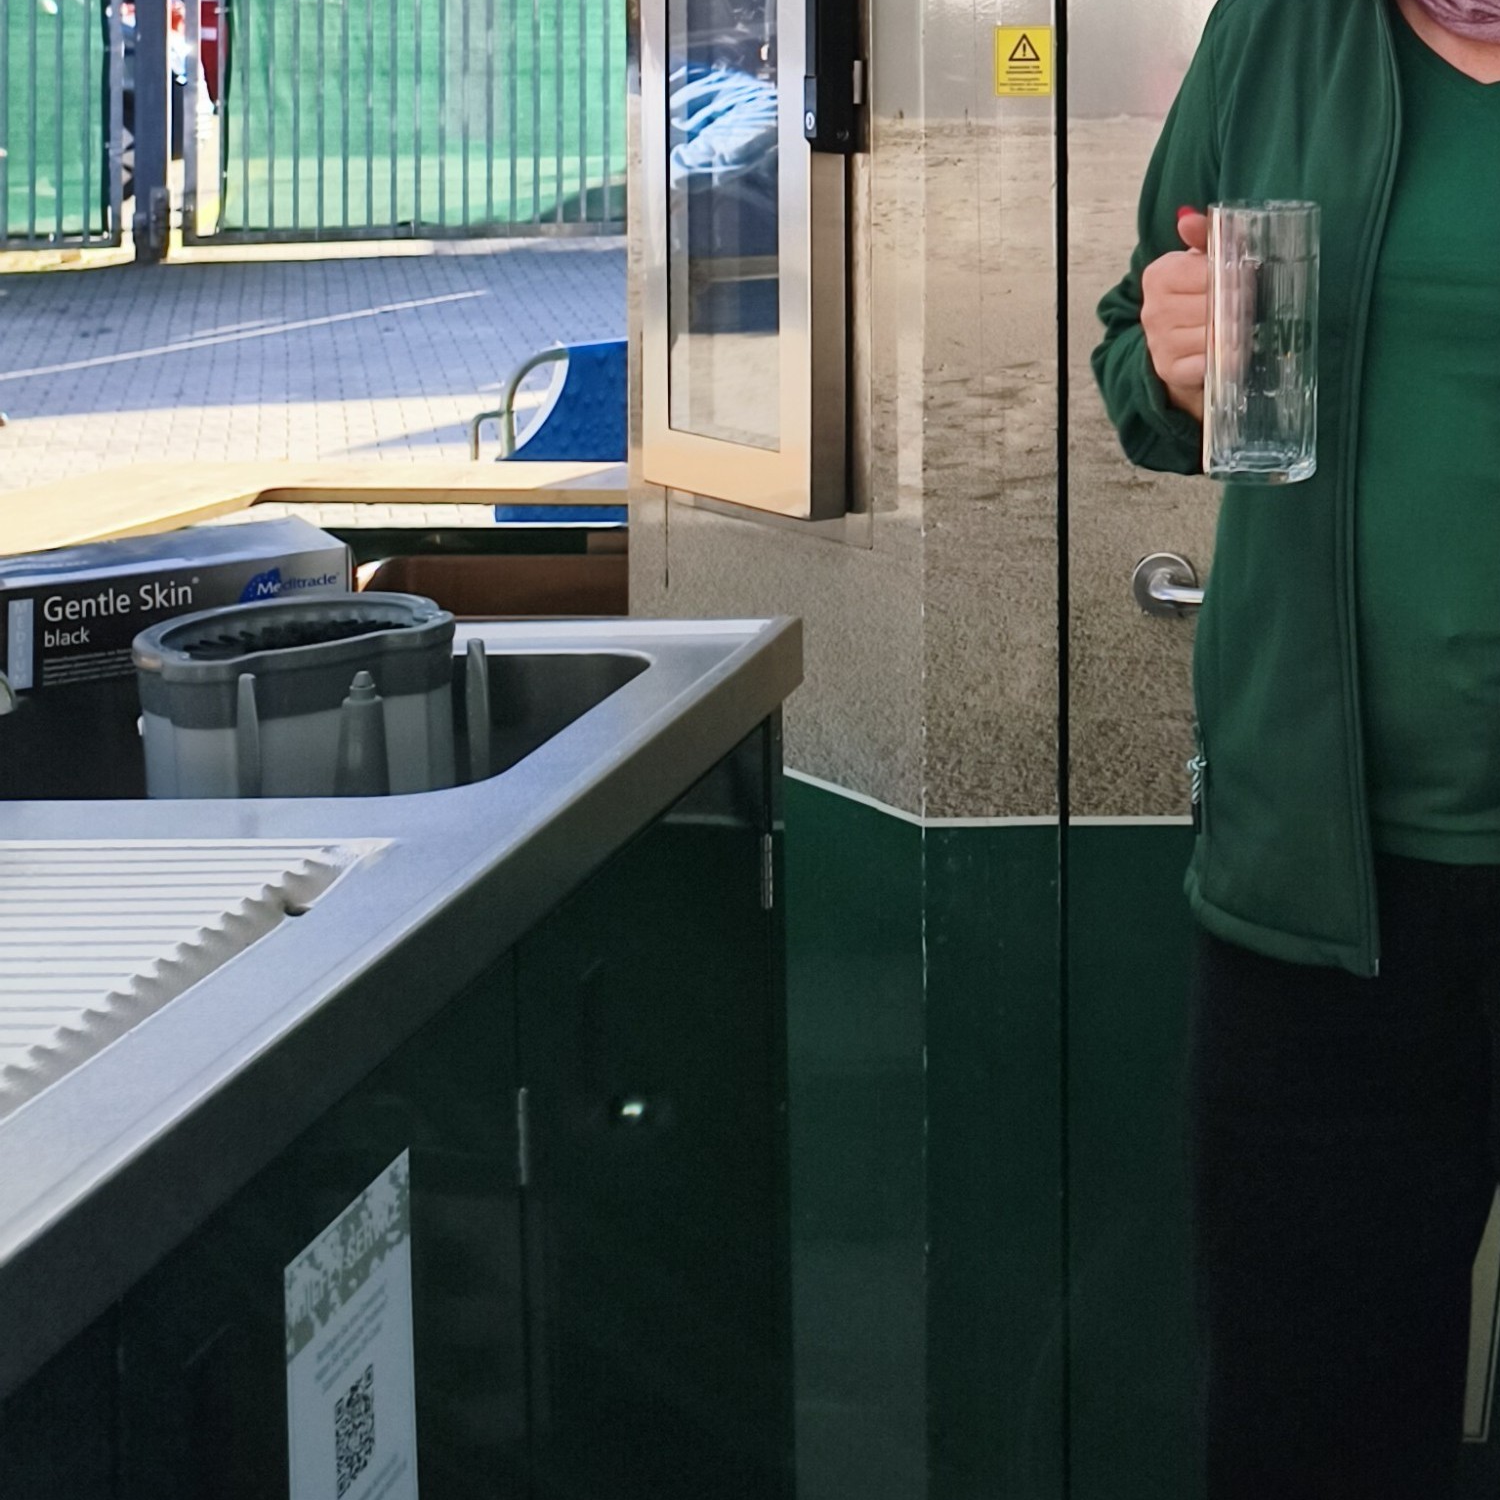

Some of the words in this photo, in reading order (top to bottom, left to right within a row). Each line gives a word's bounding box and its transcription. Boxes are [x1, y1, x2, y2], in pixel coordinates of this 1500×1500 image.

[256, 573, 338, 596] Meditrade
[43, 587, 132, 622] Gentle
[138, 580, 193, 611] Skin
[44, 626, 91, 648] black
